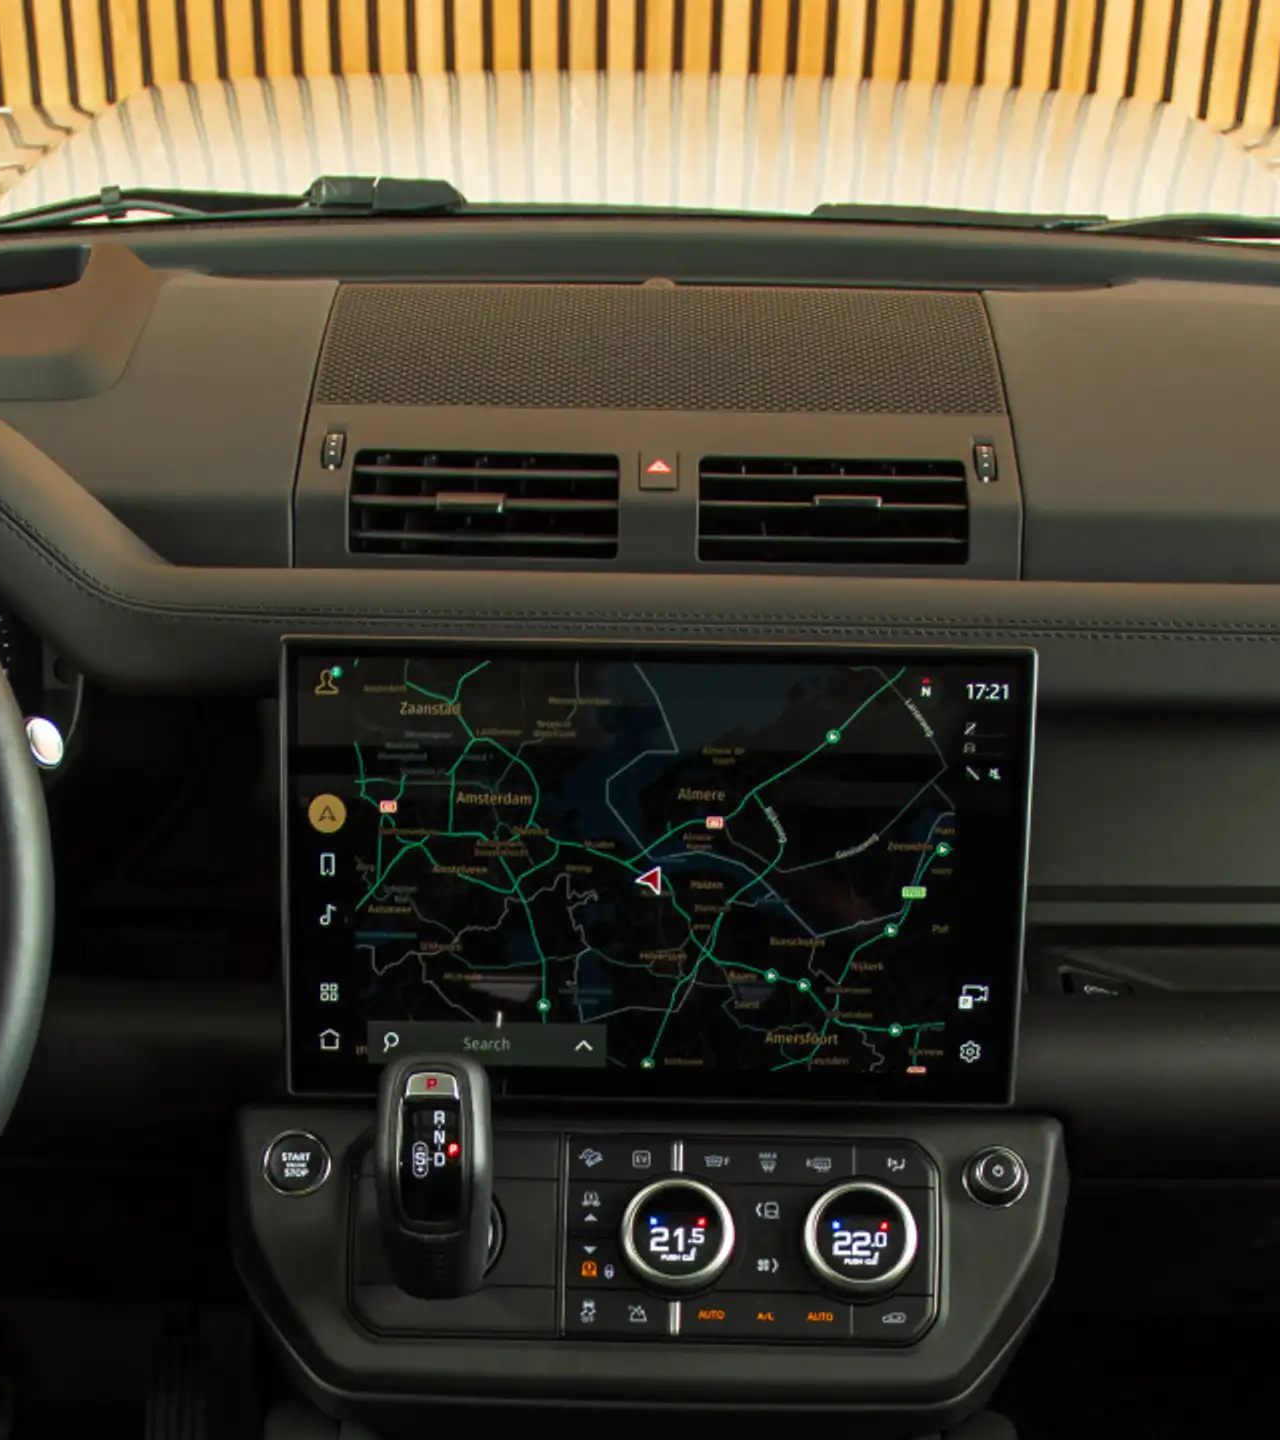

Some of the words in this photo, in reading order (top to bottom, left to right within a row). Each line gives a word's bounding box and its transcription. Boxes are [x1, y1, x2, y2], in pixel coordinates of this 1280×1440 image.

[920, 685, 932, 697] N
[966, 683, 1010, 701] 17:21
[400, 702, 461, 716] Zaanstad
[455, 792, 533, 806] Amsterdam
[677, 787, 726, 802] Almere
[463, 1038, 510, 1051] Search
[764, 1032, 839, 1046] Amersfoort
[425, 1078, 438, 1090] P
[433, 1110, 445, 1125] R
[433, 1130, 445, 1144] N
[281, 1152, 312, 1161] START
[415, 1153, 426, 1165] S
[433, 1152, 445, 1167] D
[284, 1168, 310, 1178] STOP
[649, 1226, 706, 1252] 21.5
[831, 1230, 888, 1256] 22.0
[697, 1309, 726, 1319] AUTO
[756, 1311, 775, 1321] A/C
[807, 1311, 833, 1322] AUTO
